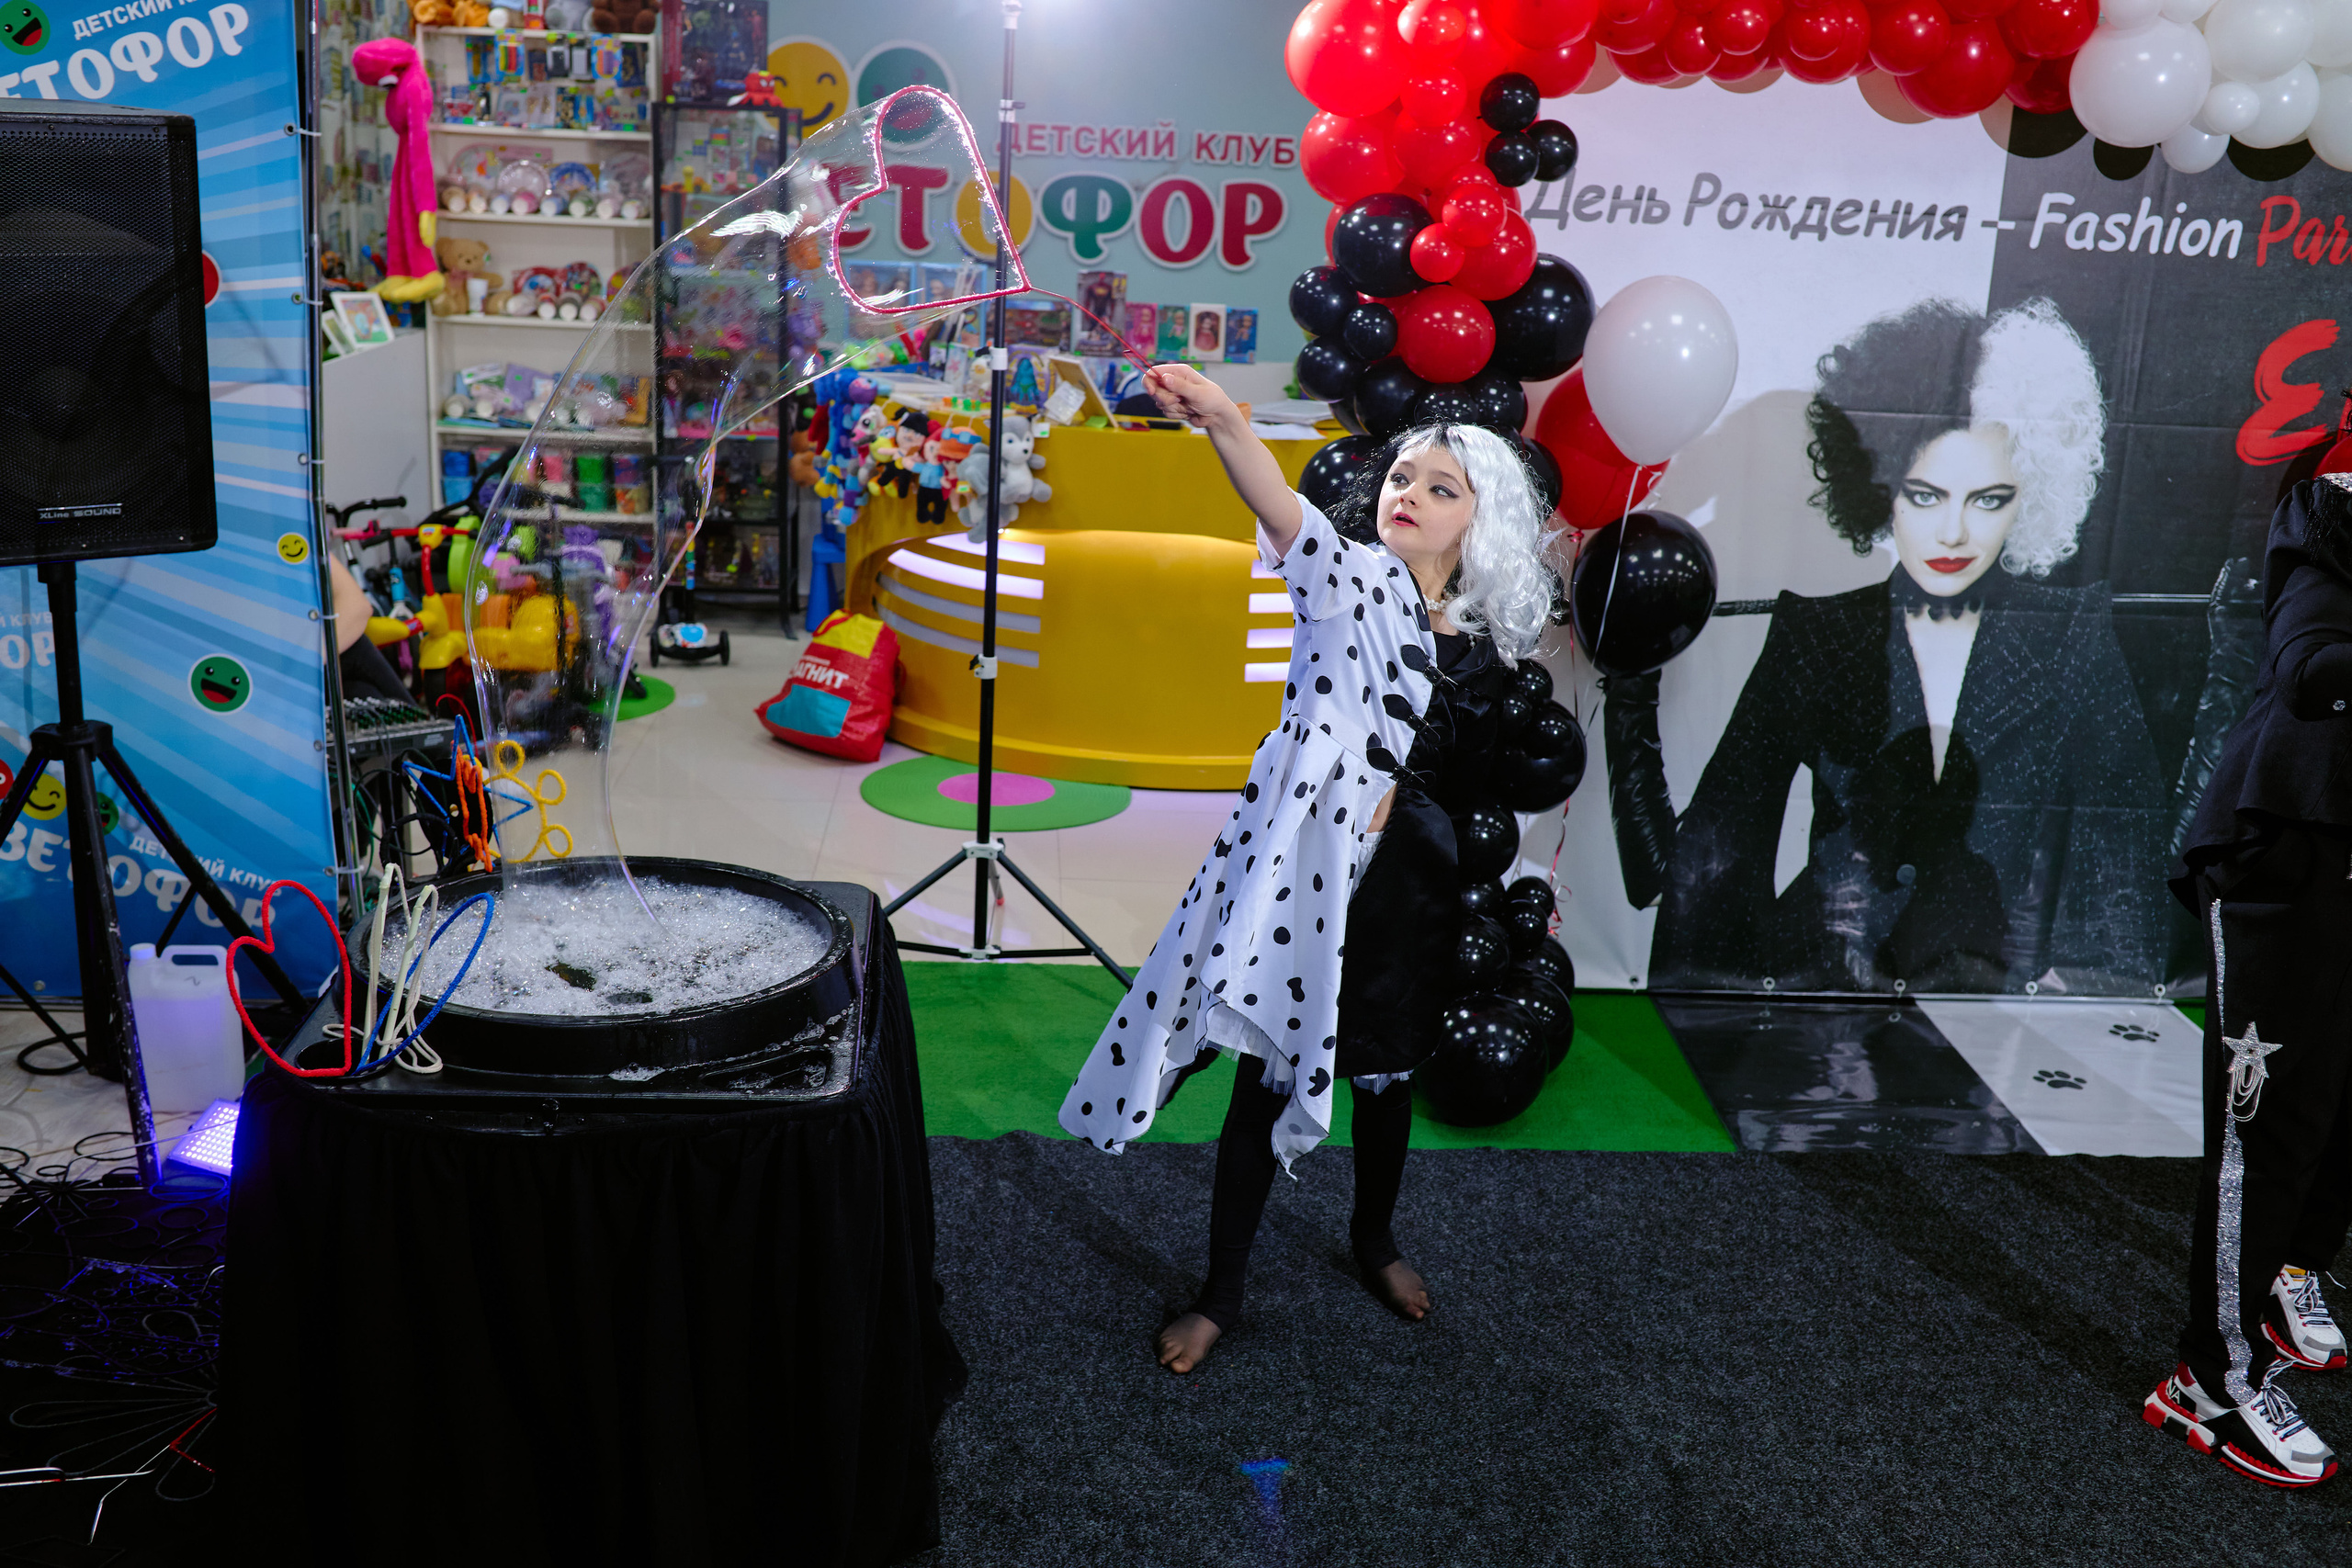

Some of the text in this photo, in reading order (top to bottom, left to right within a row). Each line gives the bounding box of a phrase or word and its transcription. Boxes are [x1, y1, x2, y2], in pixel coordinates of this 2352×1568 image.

[1195, 132, 1295, 165] КЛУБ
[1524, 167, 1671, 231] День
[1683, 172, 1969, 242] Рождения
[2029, 191, 2244, 260] Fashion
[2256, 195, 2352, 267] Par
[2235, 319, 2352, 467] E
[74, 507, 121, 517] SOUND
[789, 660, 850, 689] АГНИТ
